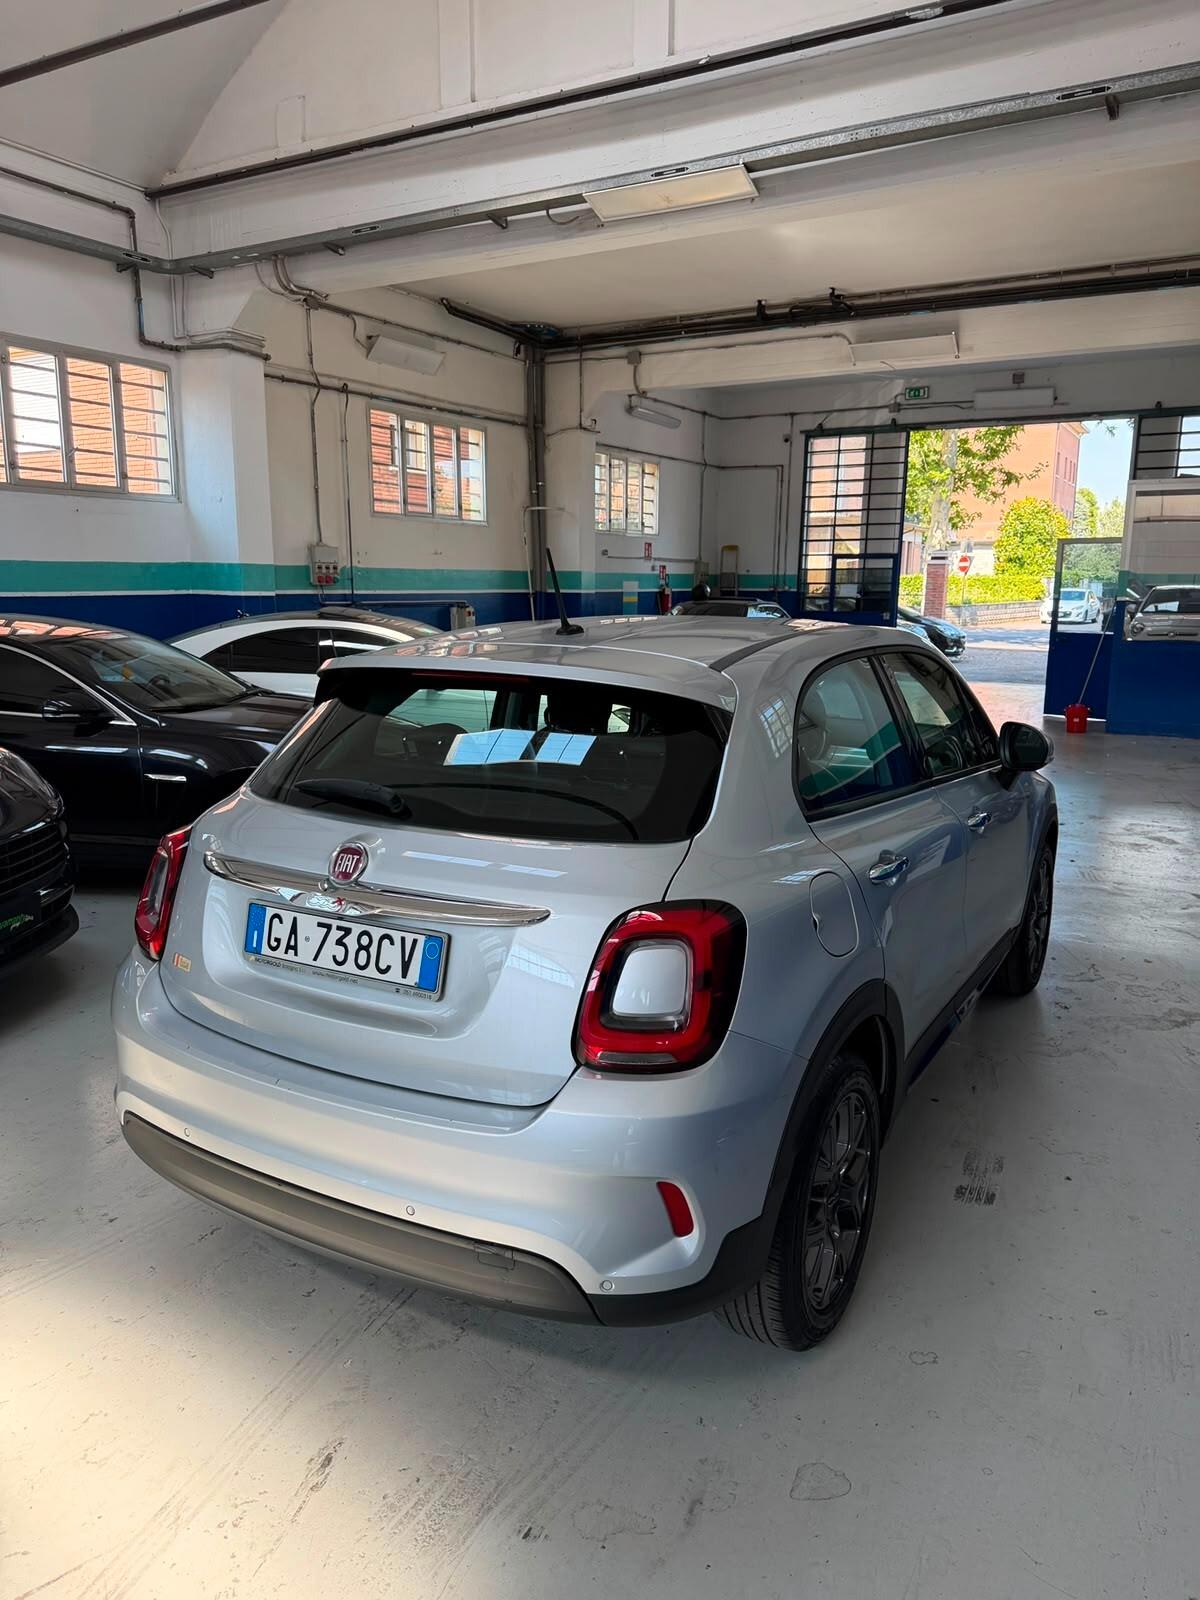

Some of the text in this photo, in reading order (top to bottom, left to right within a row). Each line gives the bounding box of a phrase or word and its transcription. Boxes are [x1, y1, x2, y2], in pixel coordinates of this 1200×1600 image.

[334, 853, 360, 873] FIAT
[266, 912, 419, 979] GA 738CV
